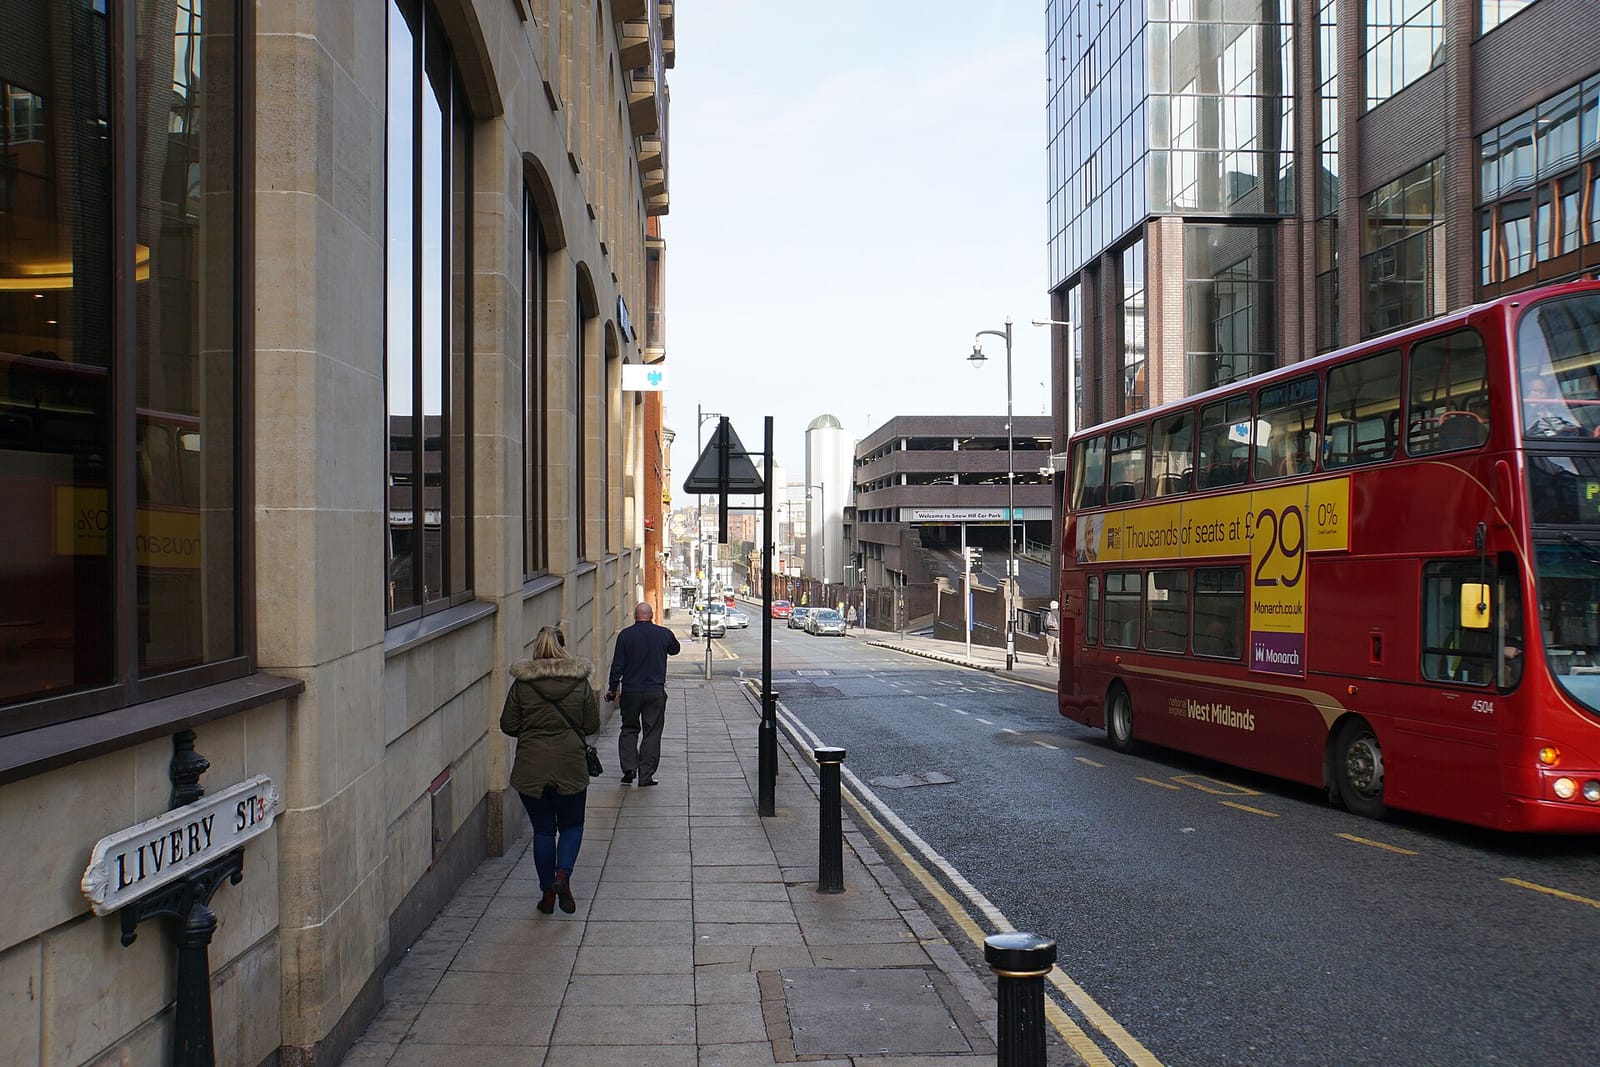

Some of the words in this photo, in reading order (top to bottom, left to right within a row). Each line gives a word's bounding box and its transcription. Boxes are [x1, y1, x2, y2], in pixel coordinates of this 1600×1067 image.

[1317, 502, 1338, 527] 0%
[1126, 522, 1178, 549] Thousands
[1181, 517, 1193, 544] of
[1196, 521, 1225, 543] seats
[1228, 517, 1240, 540] at
[1254, 600, 1302, 615] Monarch.co.uk
[1265, 648, 1299, 665] Monarch
[1187, 698, 1210, 722] West
[1211, 703, 1255, 732] Midlands
[1472, 699, 1494, 714] 4504
[116, 813, 216, 892] LIVERY
